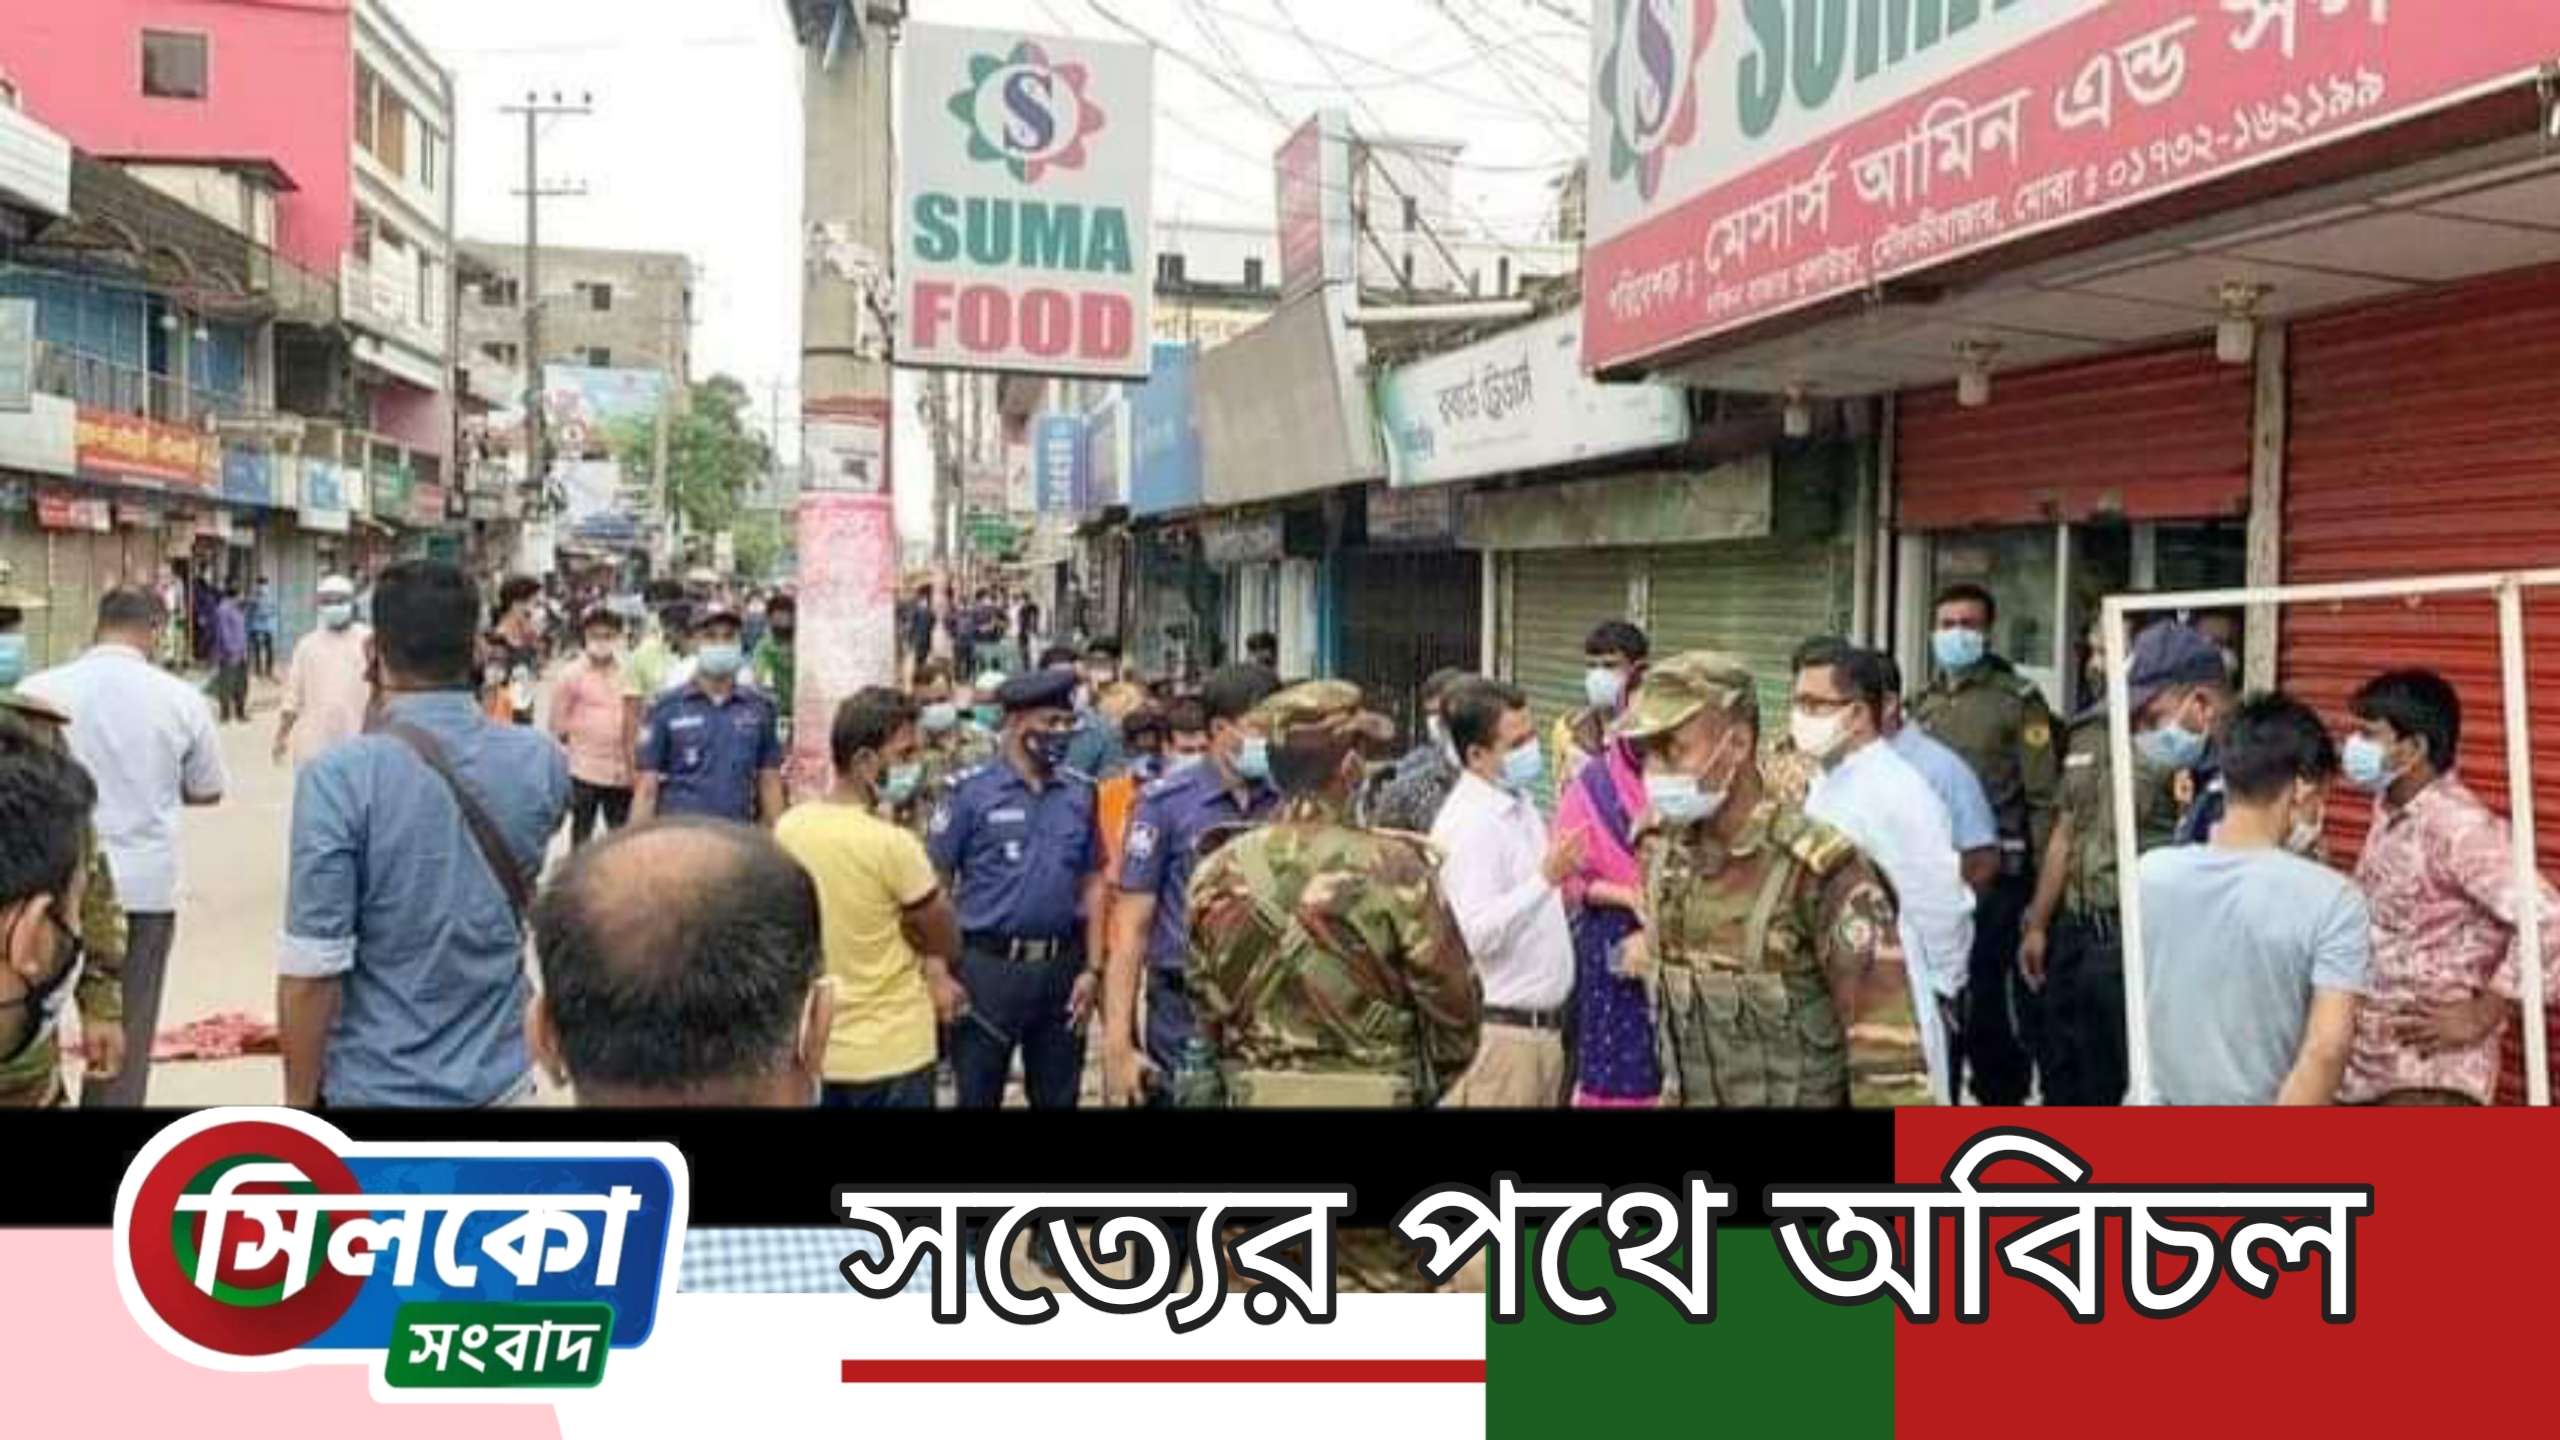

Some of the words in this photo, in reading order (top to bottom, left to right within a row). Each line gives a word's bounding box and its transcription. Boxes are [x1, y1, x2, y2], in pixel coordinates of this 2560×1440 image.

[1704, 145, 1838, 273] মেসার্স
[1850, 98, 2033, 207] আমিন
[2056, 15, 2197, 129] এন্ড
[2108, 66, 2384, 186] ০১৭৩২-১৬২১৯৯
[913, 194, 1134, 275] SUMA
[912, 283, 1134, 361] FOOD
